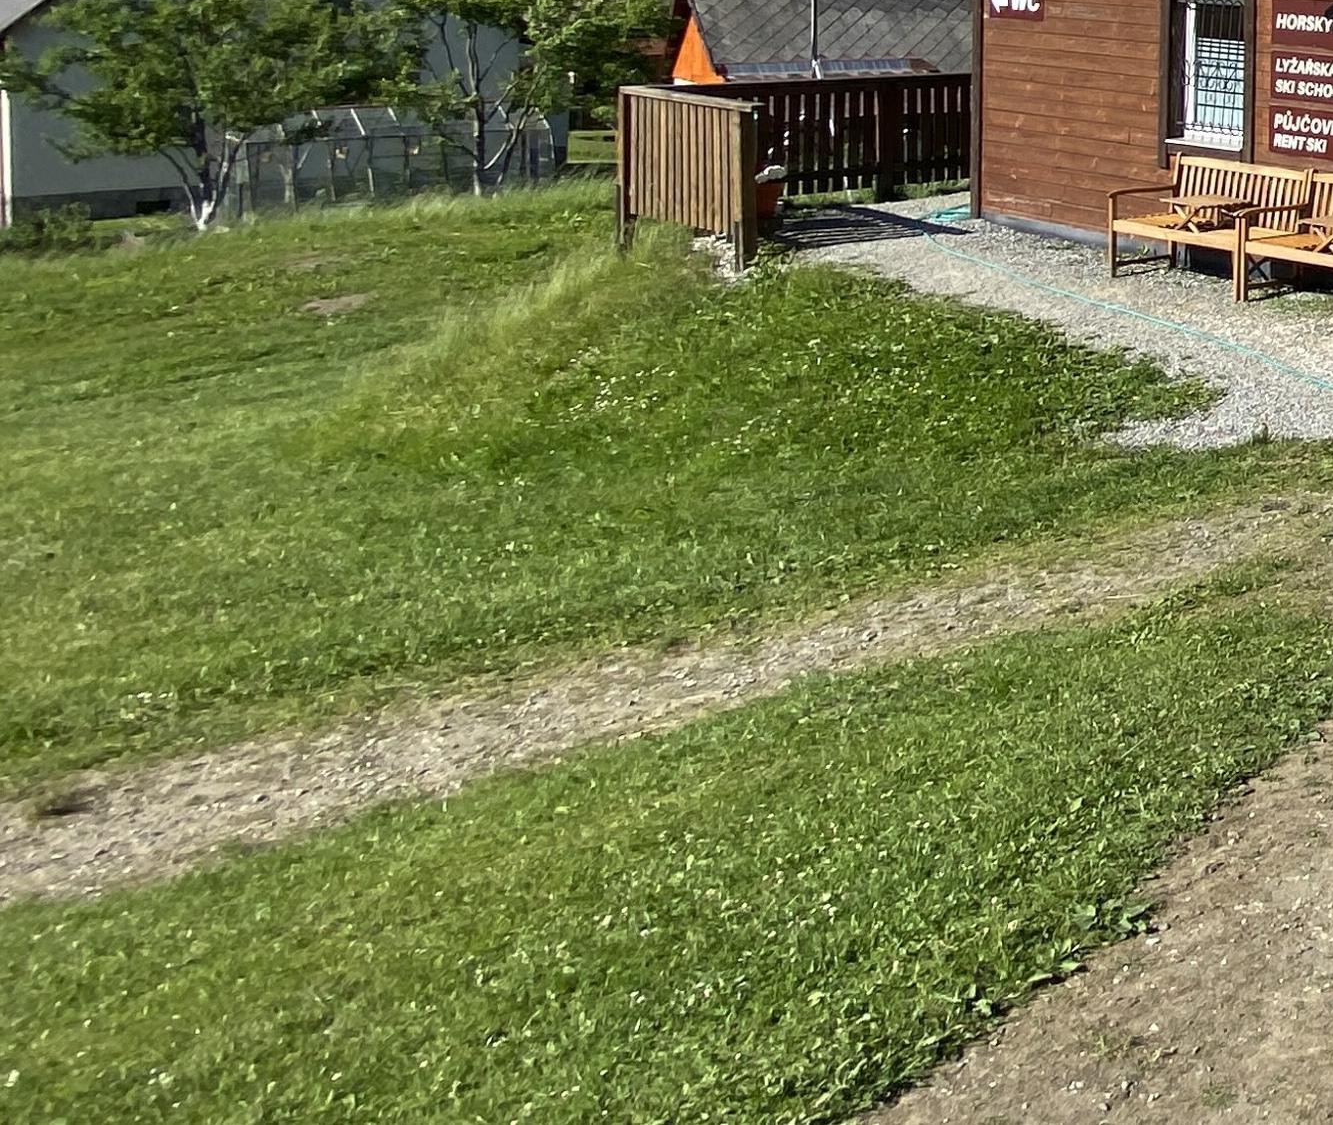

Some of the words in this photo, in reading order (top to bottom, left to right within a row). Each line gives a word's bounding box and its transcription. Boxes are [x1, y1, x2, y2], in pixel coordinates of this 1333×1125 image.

[1275, 78, 1296, 94] SKI
[1273, 133, 1307, 151] RENT
[1306, 137, 1328, 154] SKI
